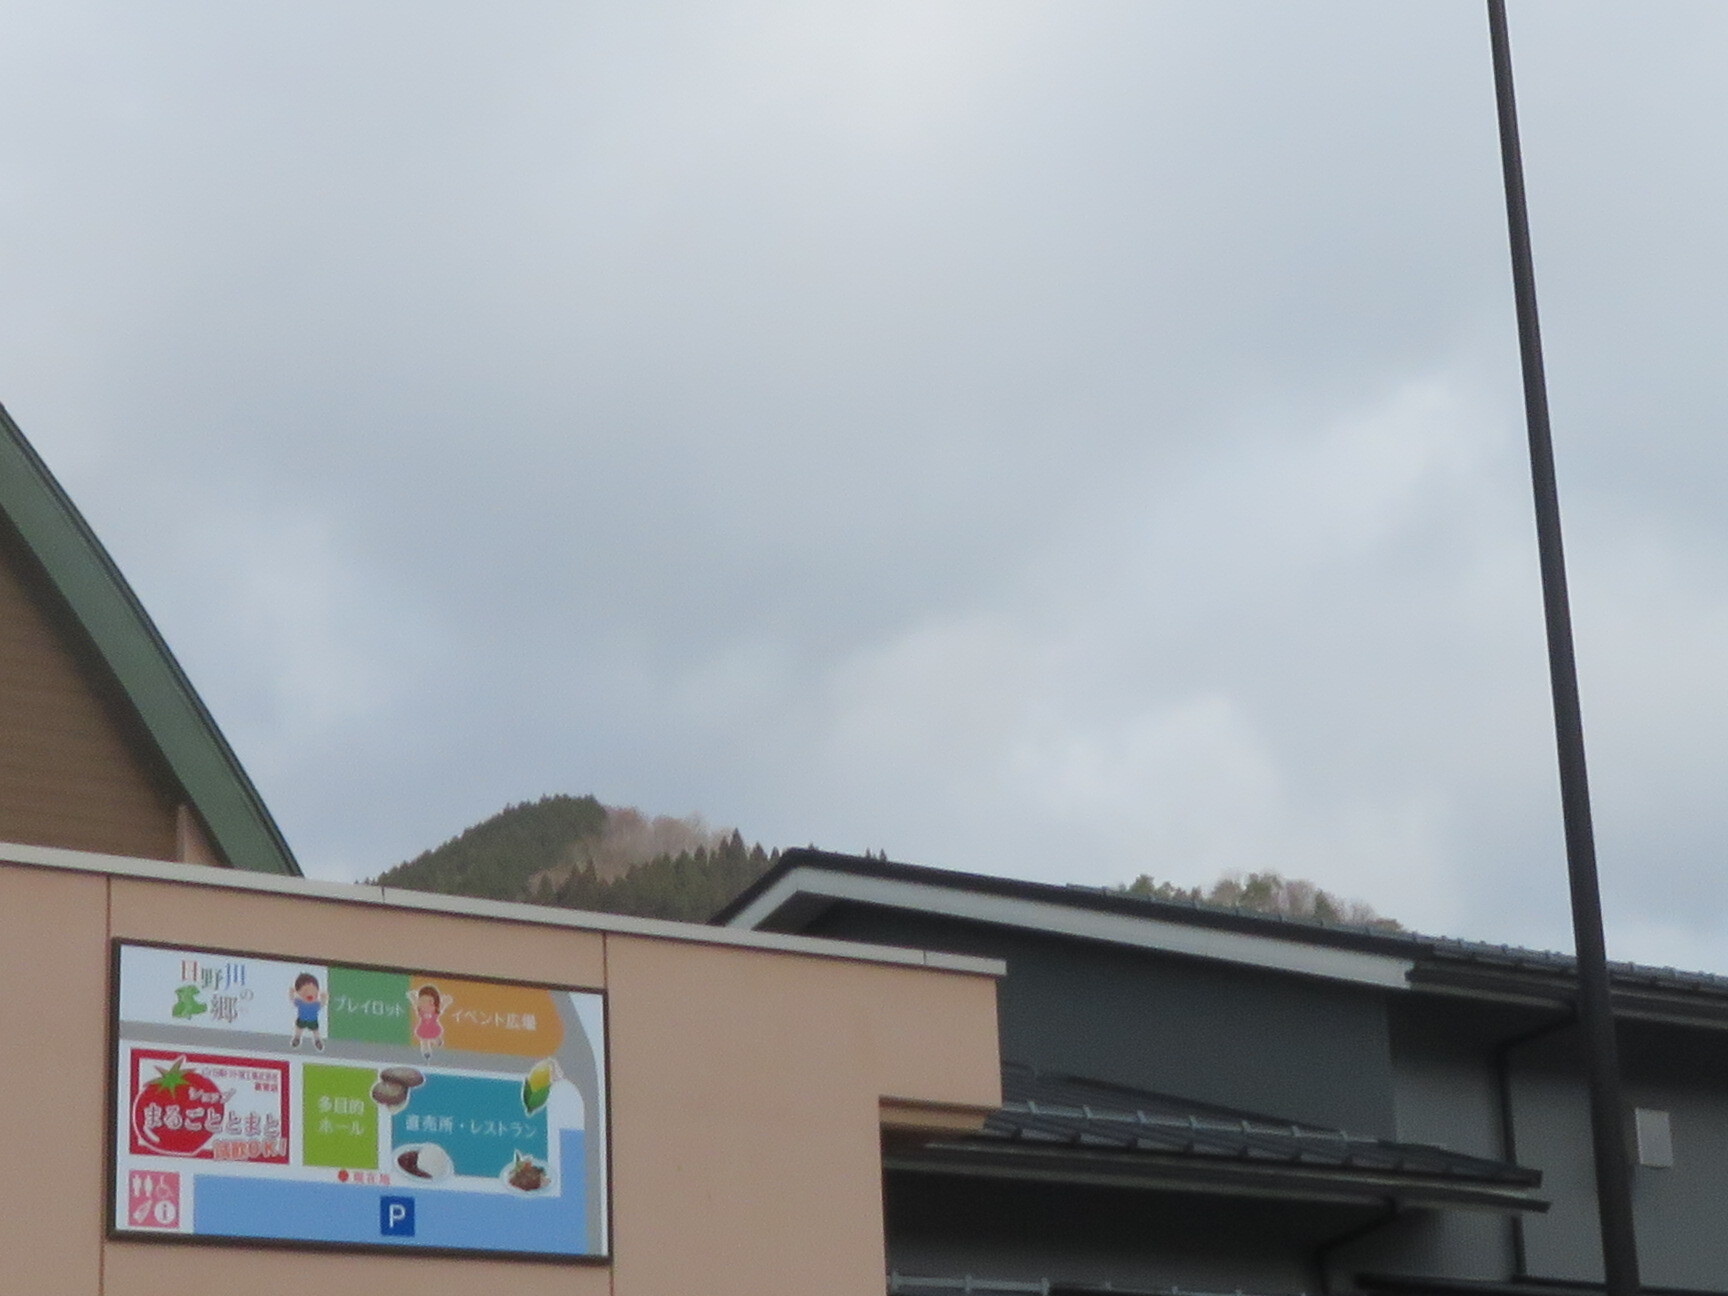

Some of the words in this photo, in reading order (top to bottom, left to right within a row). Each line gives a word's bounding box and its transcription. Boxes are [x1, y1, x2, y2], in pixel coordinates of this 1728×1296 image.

[334, 994, 405, 1017] プレイロット
[452, 1009, 537, 1032] イベント広場
[143, 1105, 281, 1139] まるごととまと
[389, 1204, 405, 1227] P
